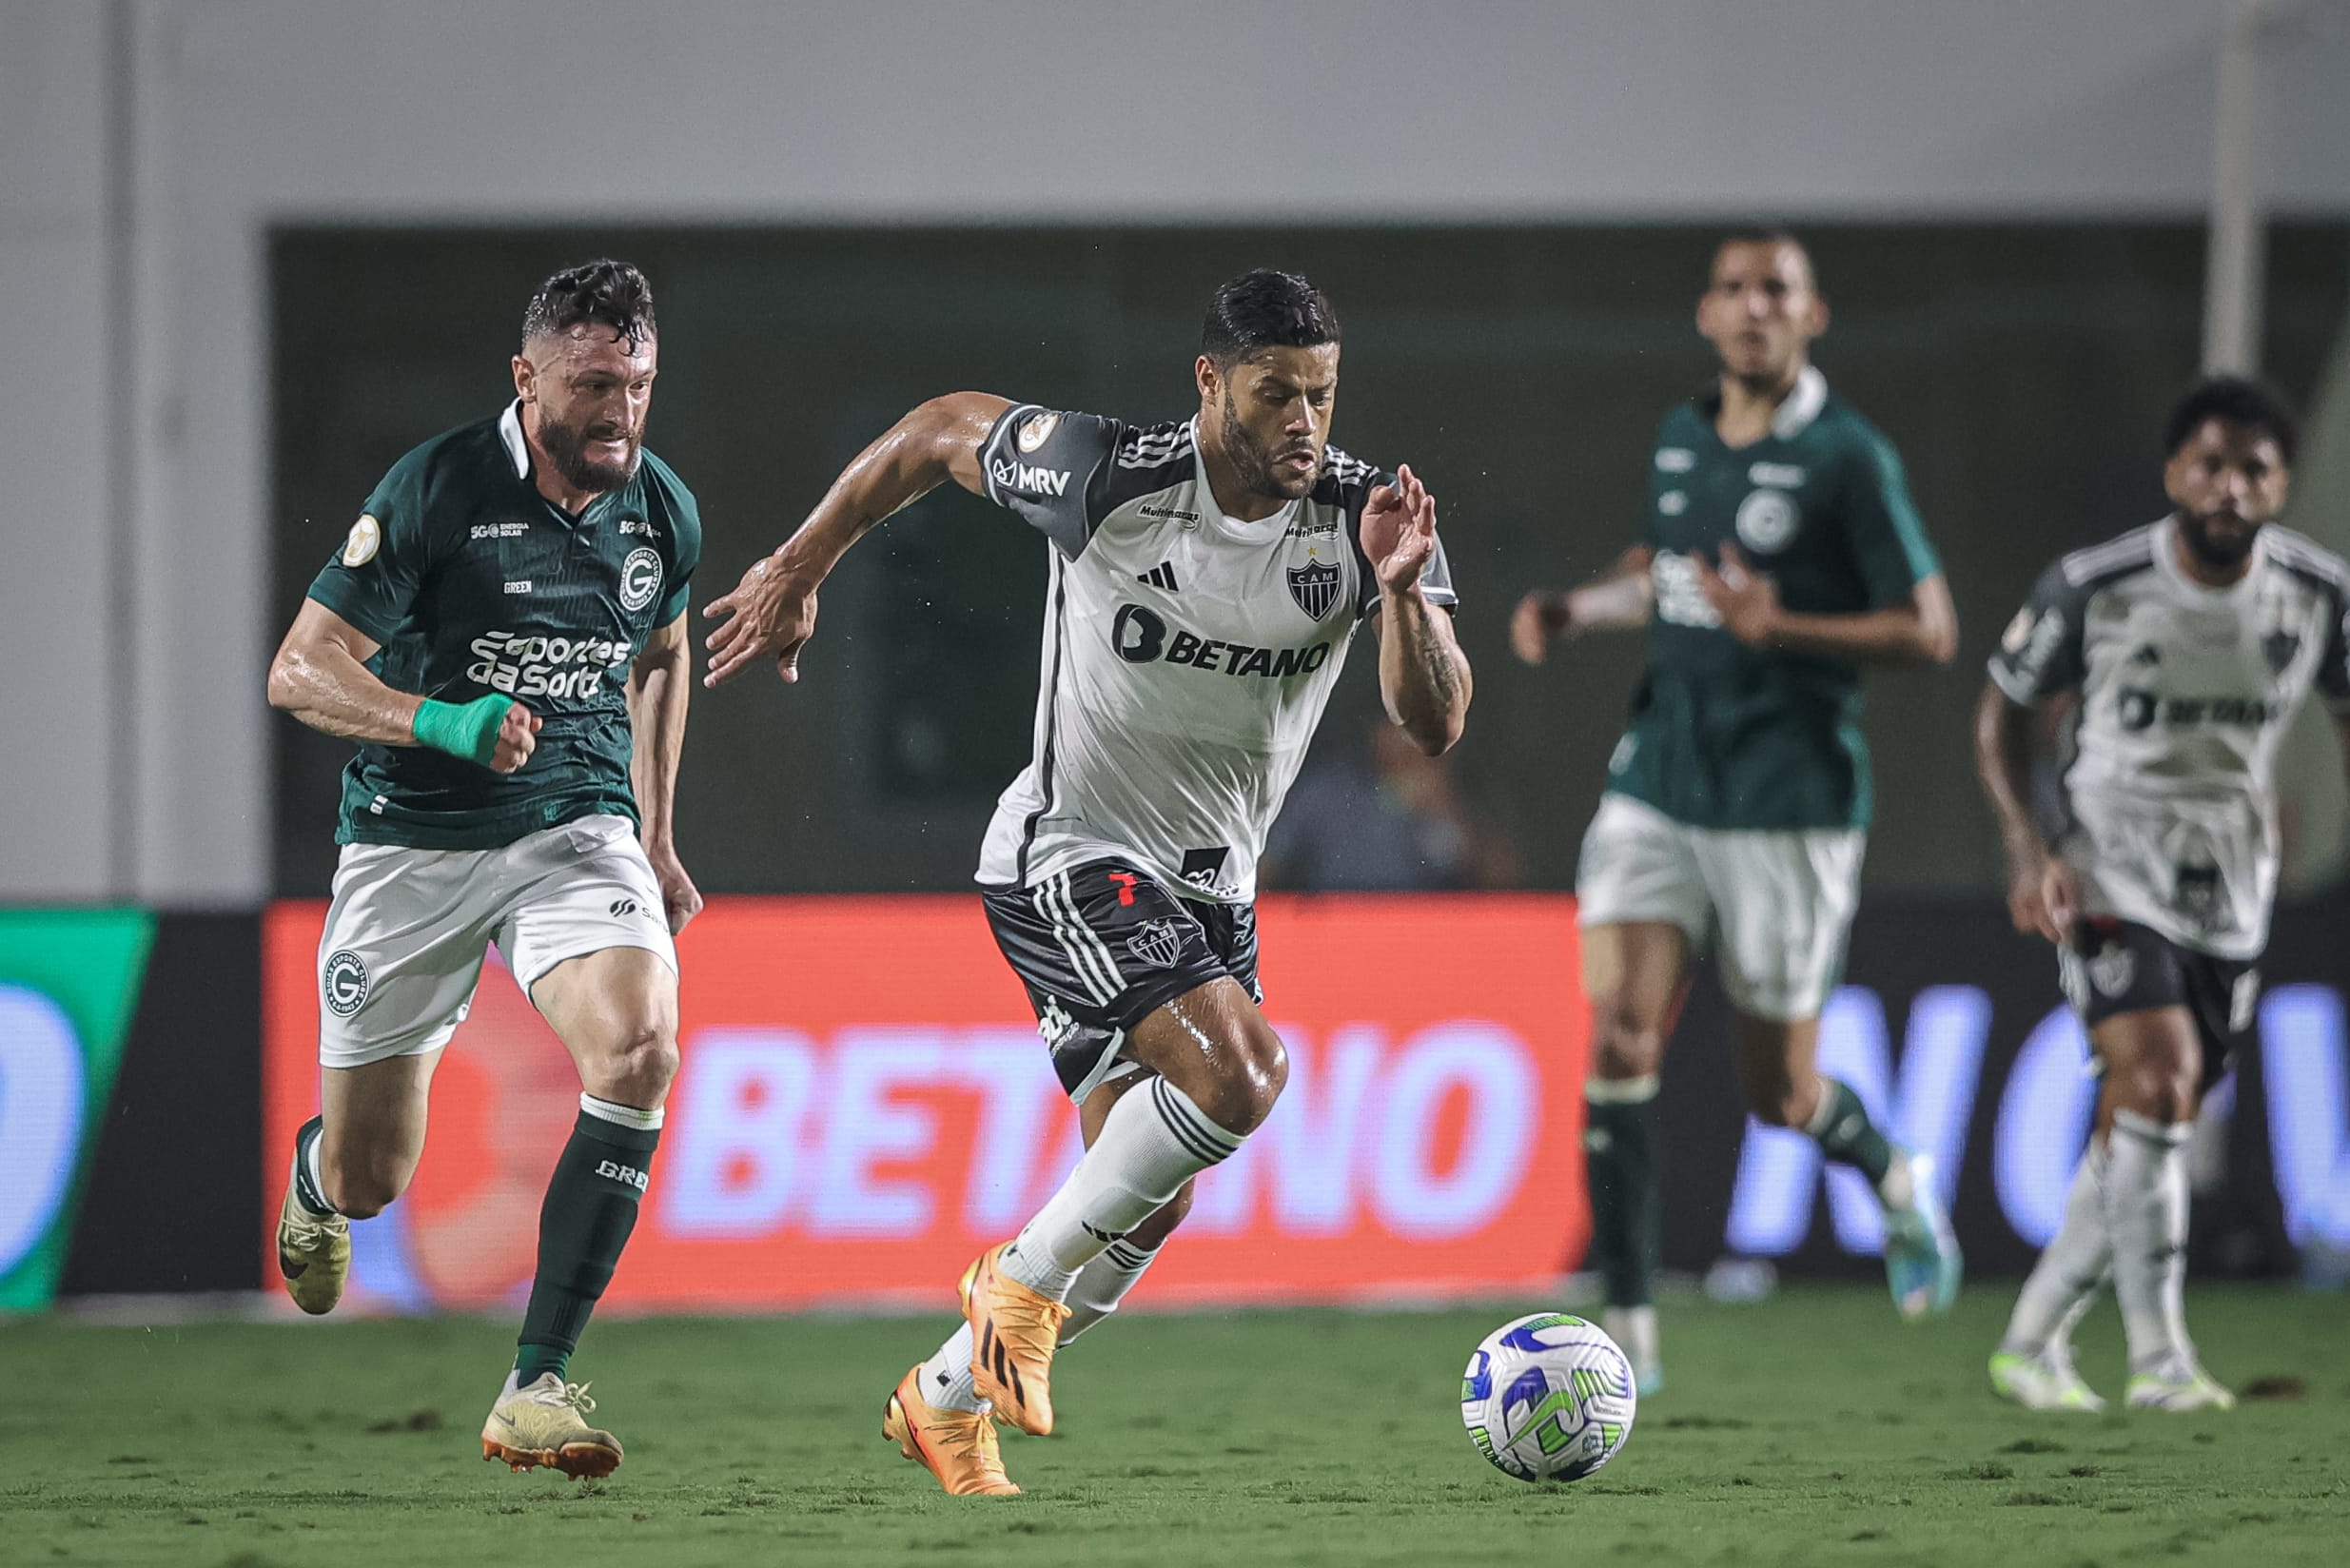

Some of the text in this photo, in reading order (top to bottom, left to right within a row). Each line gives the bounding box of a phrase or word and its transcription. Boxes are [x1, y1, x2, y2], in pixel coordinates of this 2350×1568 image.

[1018, 462, 1071, 497] MRV
[1297, 572, 1333, 584] CAM
[1165, 630, 1330, 677] BETANO
[1138, 929, 1169, 947] CAM
